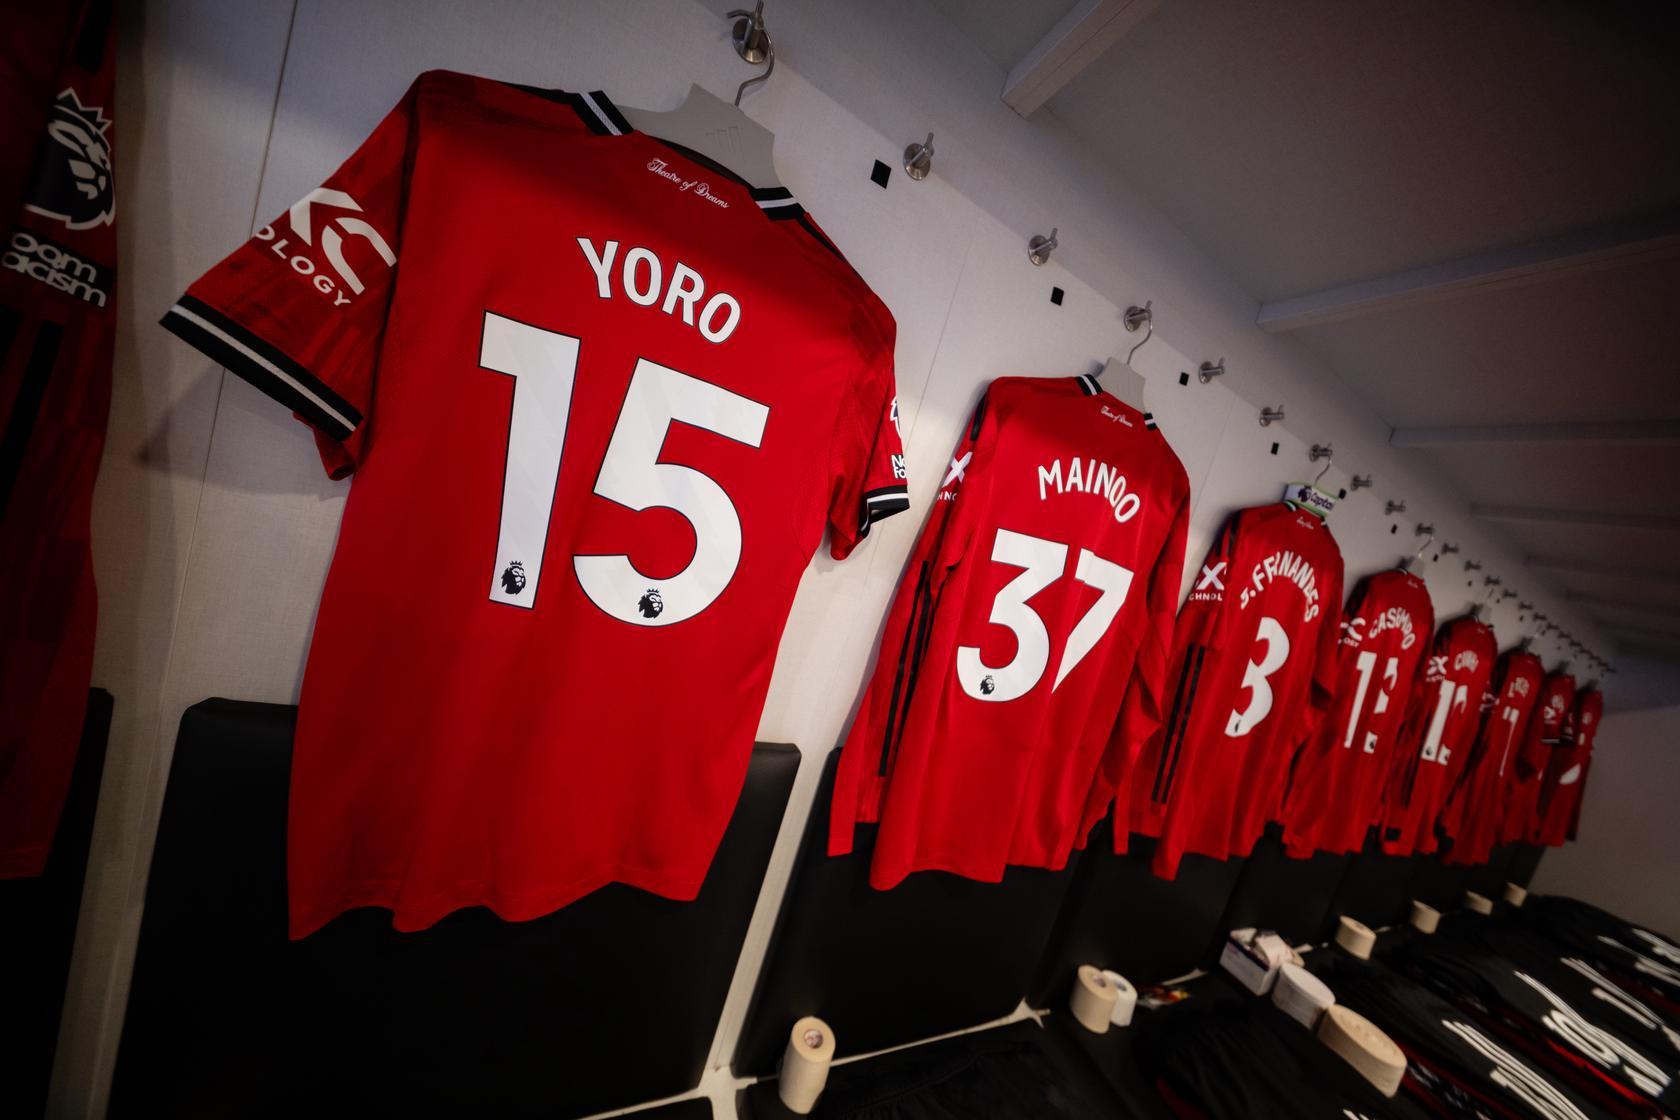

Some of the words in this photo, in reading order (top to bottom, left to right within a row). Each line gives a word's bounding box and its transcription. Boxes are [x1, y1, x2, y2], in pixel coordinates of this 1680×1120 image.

[646, 157, 682, 184] Theatre
[679, 180, 698, 192] of
[694, 182, 729, 209] Dreams
[576, 236, 743, 345] YORO
[478, 309, 771, 627] 15
[1038, 457, 1141, 524] MAINOO
[956, 528, 1135, 702] 37
